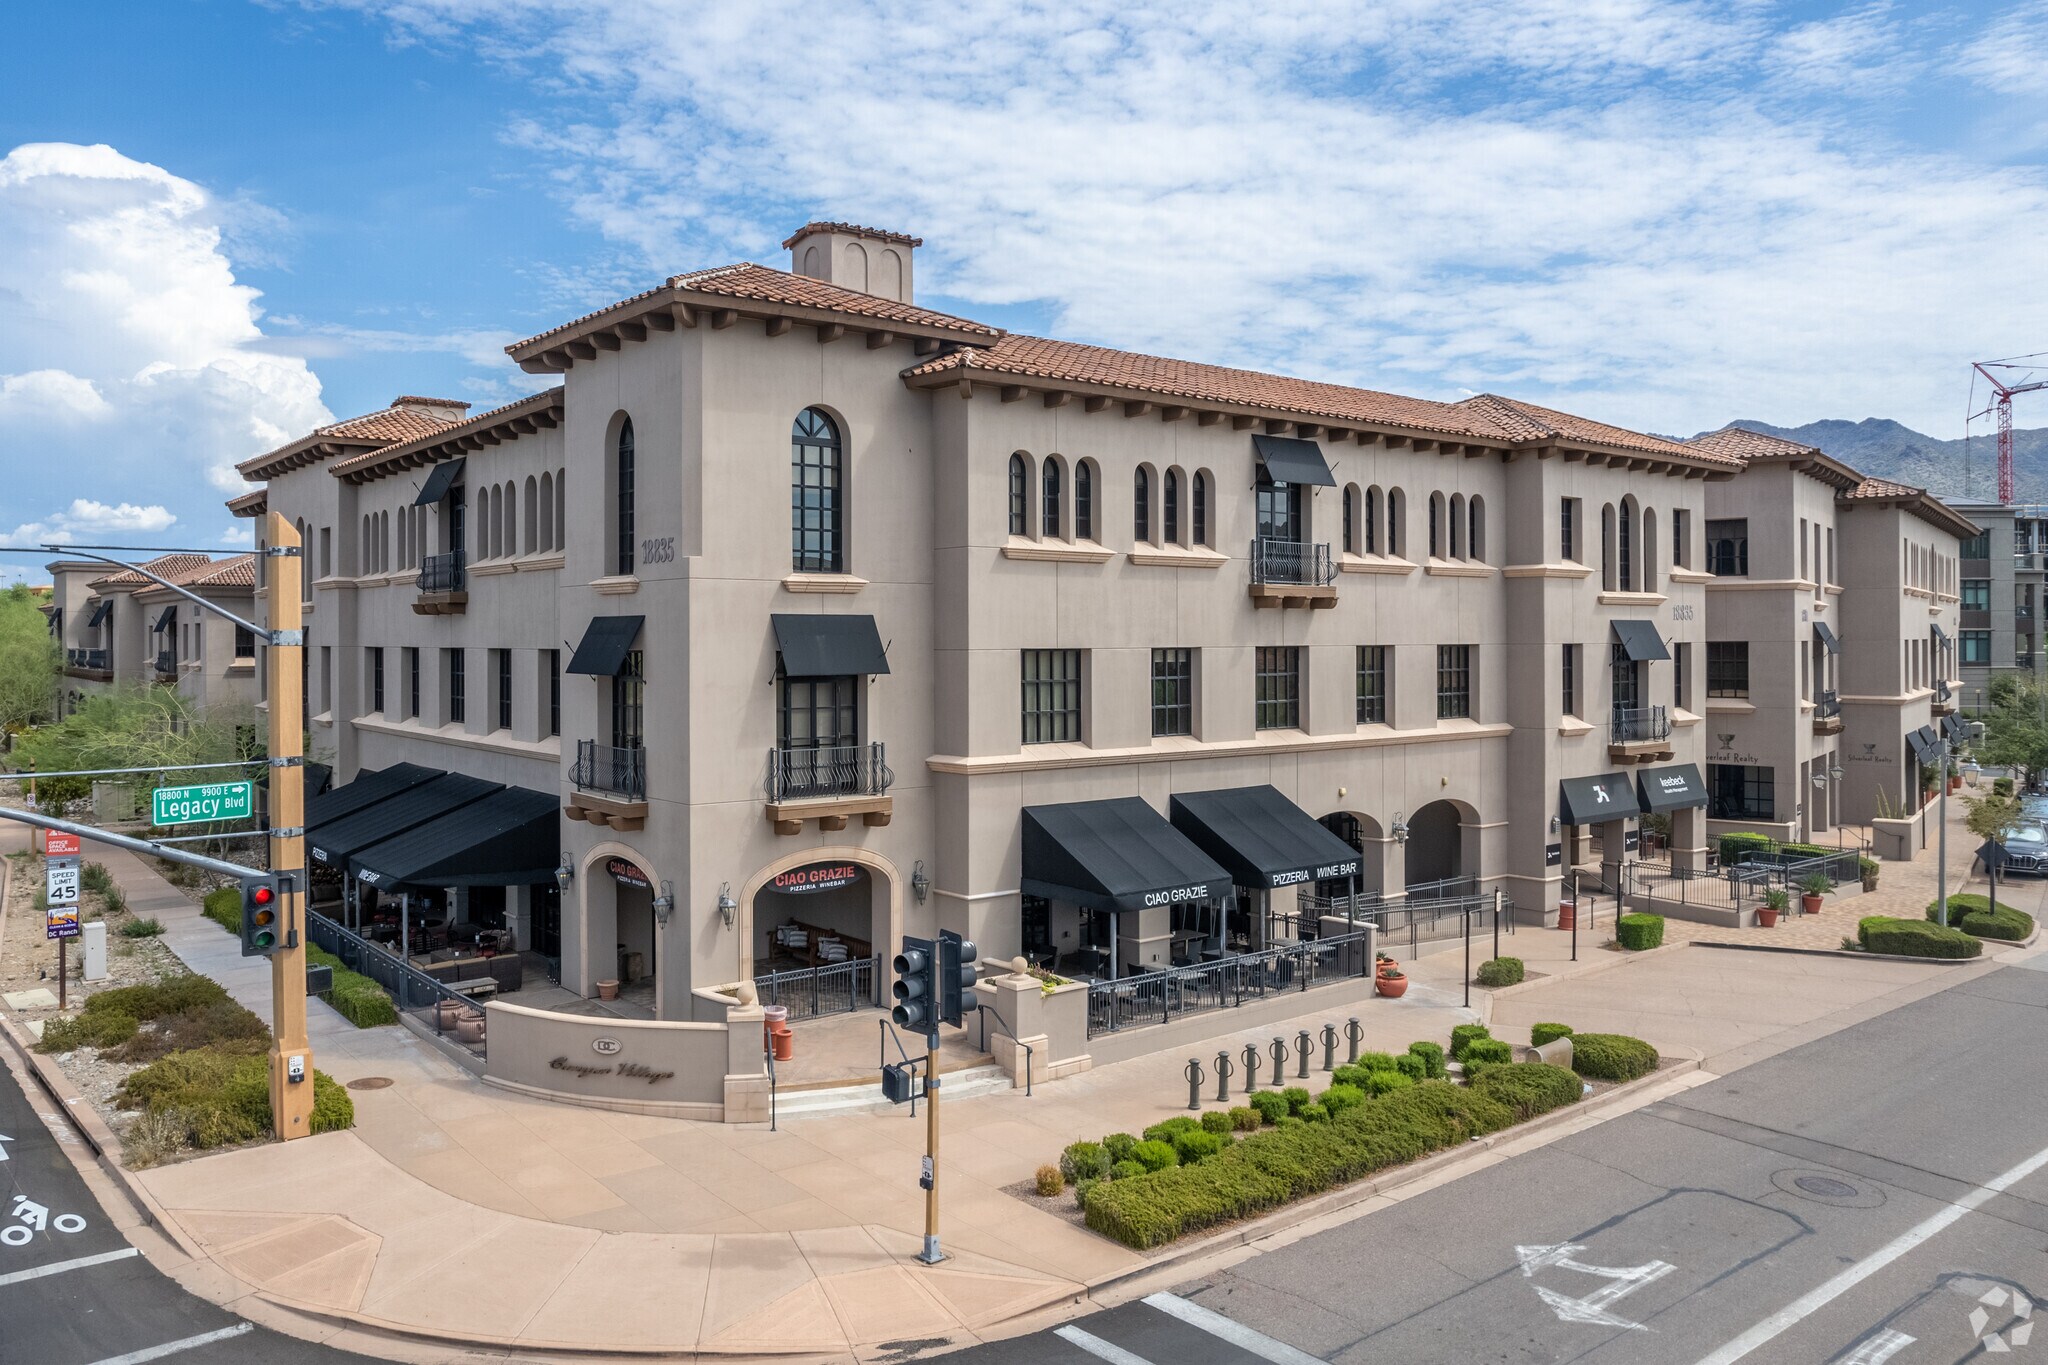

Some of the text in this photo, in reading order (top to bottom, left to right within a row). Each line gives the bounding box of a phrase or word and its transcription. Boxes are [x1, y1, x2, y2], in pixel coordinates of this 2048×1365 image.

[641, 536, 675, 565] 18835
[1733, 752, 1758, 764] Realty
[159, 786, 229, 801] 18800 N 9900 E
[161, 796, 244, 820] Legacy Blvd
[51, 871, 75, 879] SPEED
[610, 861, 648, 881] CIAO GRAZ
[775, 865, 855, 887] CIAO GRAZIE
[1273, 862, 1357, 886] PIZZERIA WINE BAR
[54, 877, 72, 886] LIMIT
[789, 879, 846, 892] PIZZERIA WINEBAR
[50, 885, 76, 900] 45
[1145, 885, 1208, 906] CIAO GRAZIE
[58, 928, 78, 936] Ranch
